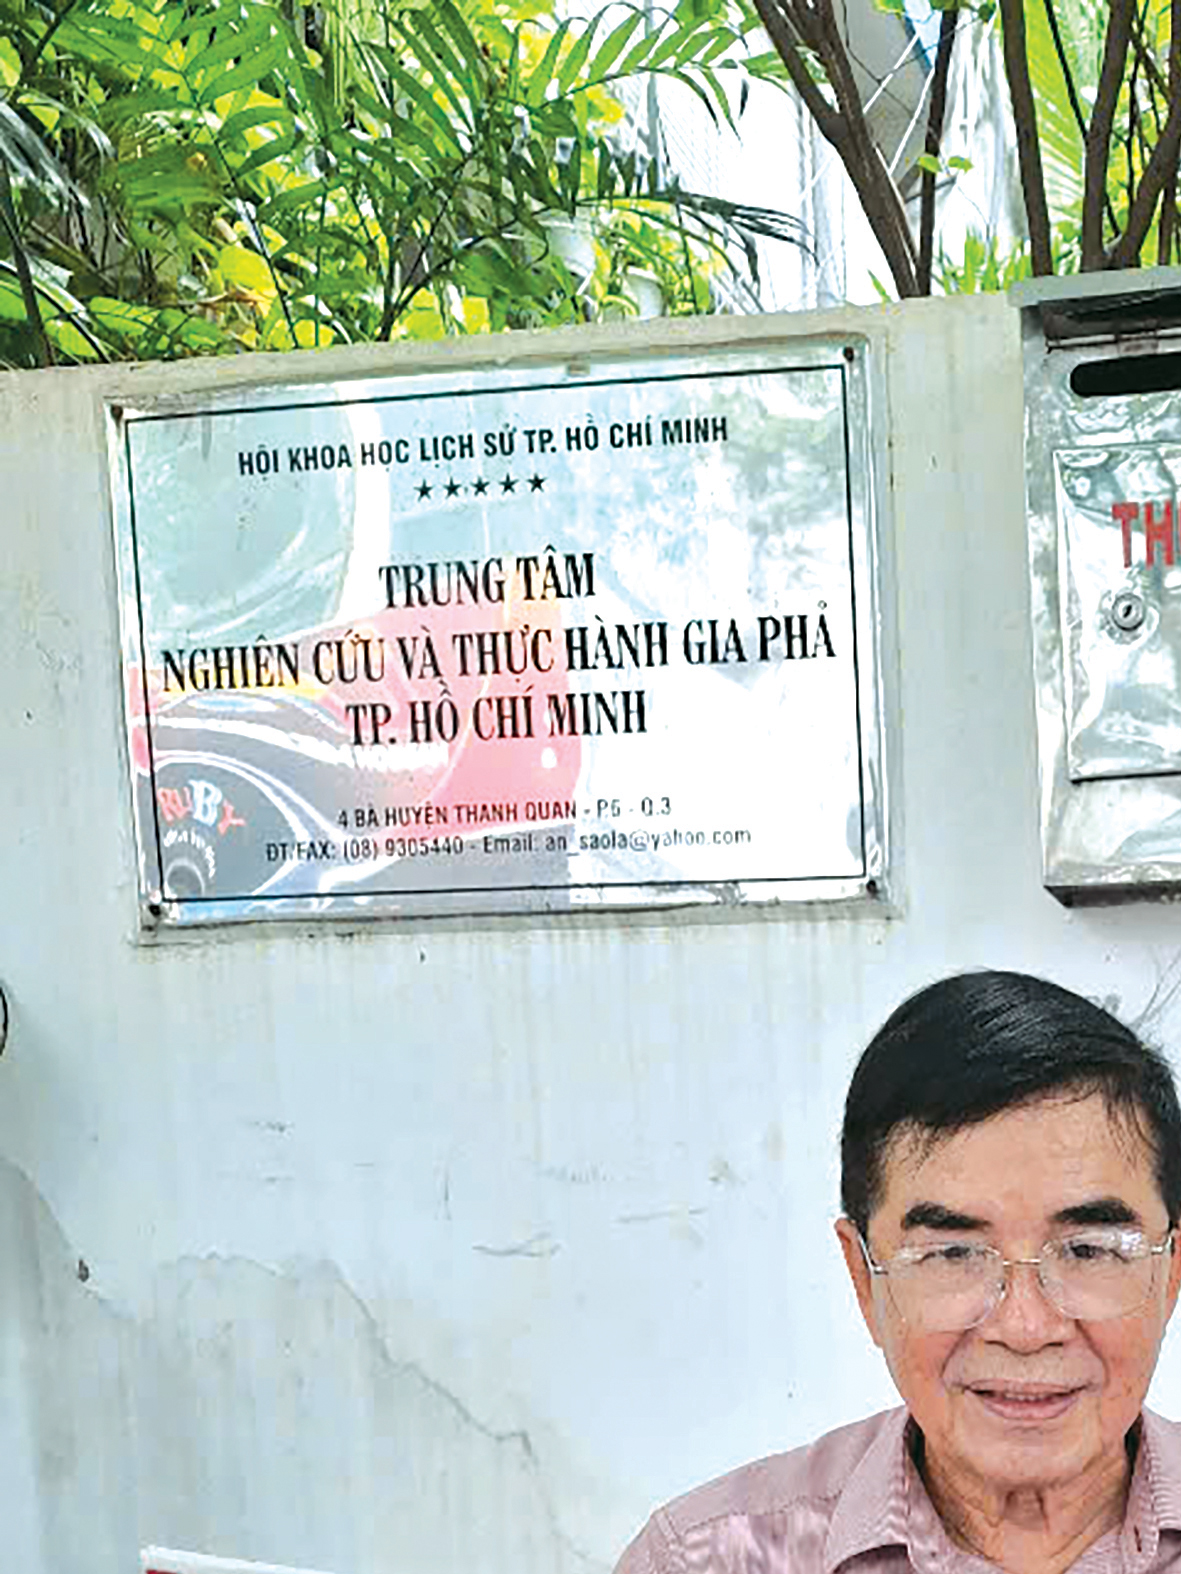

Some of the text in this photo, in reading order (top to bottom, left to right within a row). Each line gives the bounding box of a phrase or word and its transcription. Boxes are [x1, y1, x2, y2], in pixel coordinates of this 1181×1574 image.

[238, 413, 728, 482] HỘI KHOA HỌC LỊCH SỬ TP. HỒ CHÍ MINH
[379, 543, 596, 609] TRUNG TÂM
[160, 599, 837, 692] NGHIÊN CỨU VÀ THỰC HÀNH GIA PHẢ
[346, 679, 648, 746] TP. HỒ CHÍ MINH
[337, 809, 348, 828] 4
[355, 802, 380, 828] BÀ
[385, 800, 448, 829] HUYỆN
[455, 803, 519, 825] THANH
[525, 801, 577, 821] QUAN
[641, 796, 673, 818] Q.3
[343, 838, 378, 861] (08)
[385, 836, 464, 857] 9305440
[483, 833, 537, 854] Email:
